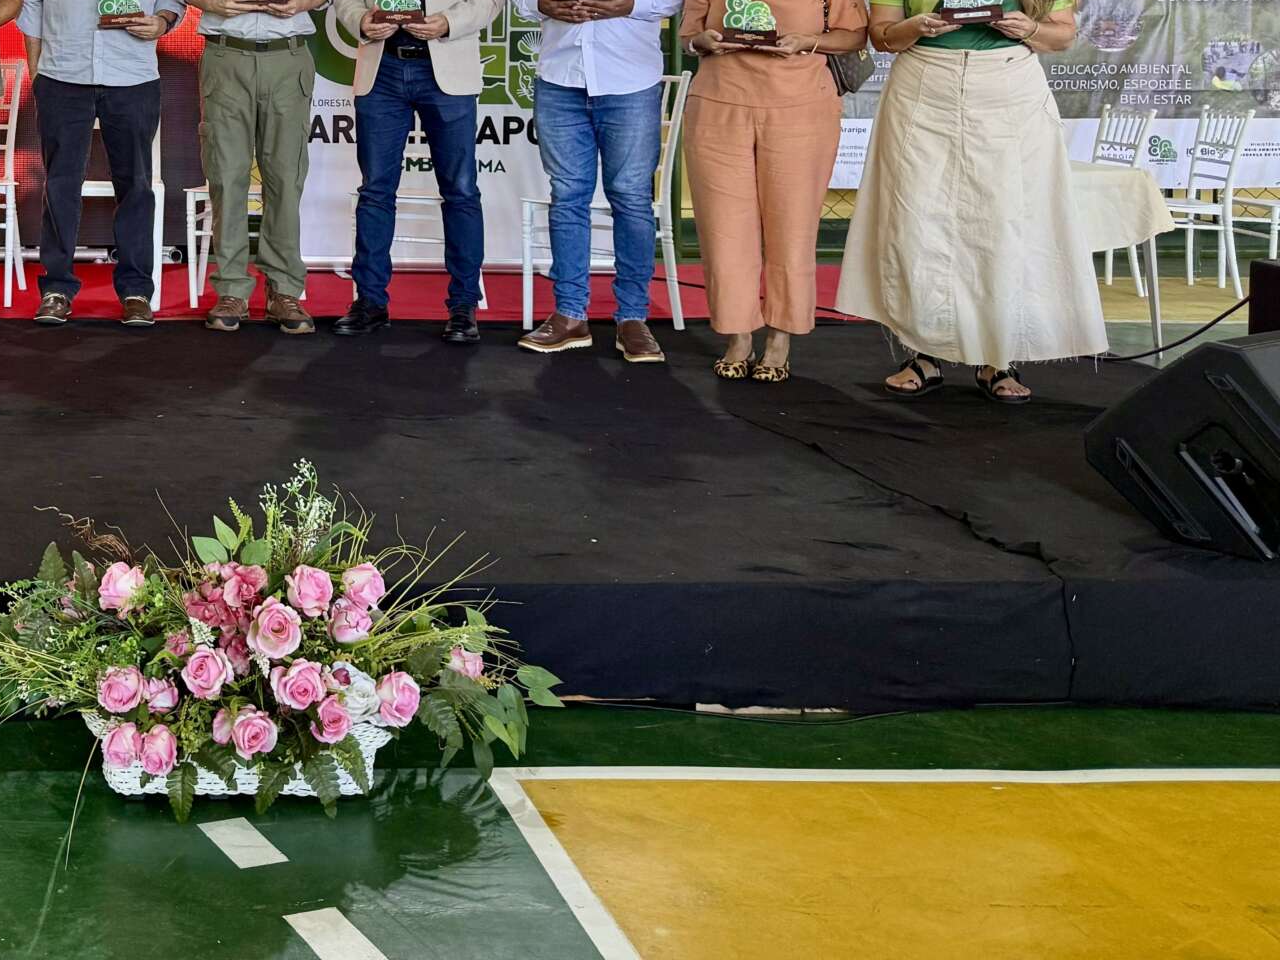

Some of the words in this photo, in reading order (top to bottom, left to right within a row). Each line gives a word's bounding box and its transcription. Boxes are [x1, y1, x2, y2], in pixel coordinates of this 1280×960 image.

[1051, 62, 1117, 77] EDUCAÇÃO
[1120, 64, 1192, 75] AMBIENTAL
[1048, 79, 1120, 91] COTURISMO,
[1124, 80, 1181, 90] ESPORTE
[1185, 80, 1192, 89] E
[312, 98, 352, 107] LORESTA
[1120, 95, 1149, 104] BEM
[1153, 95, 1192, 104] ESTAR
